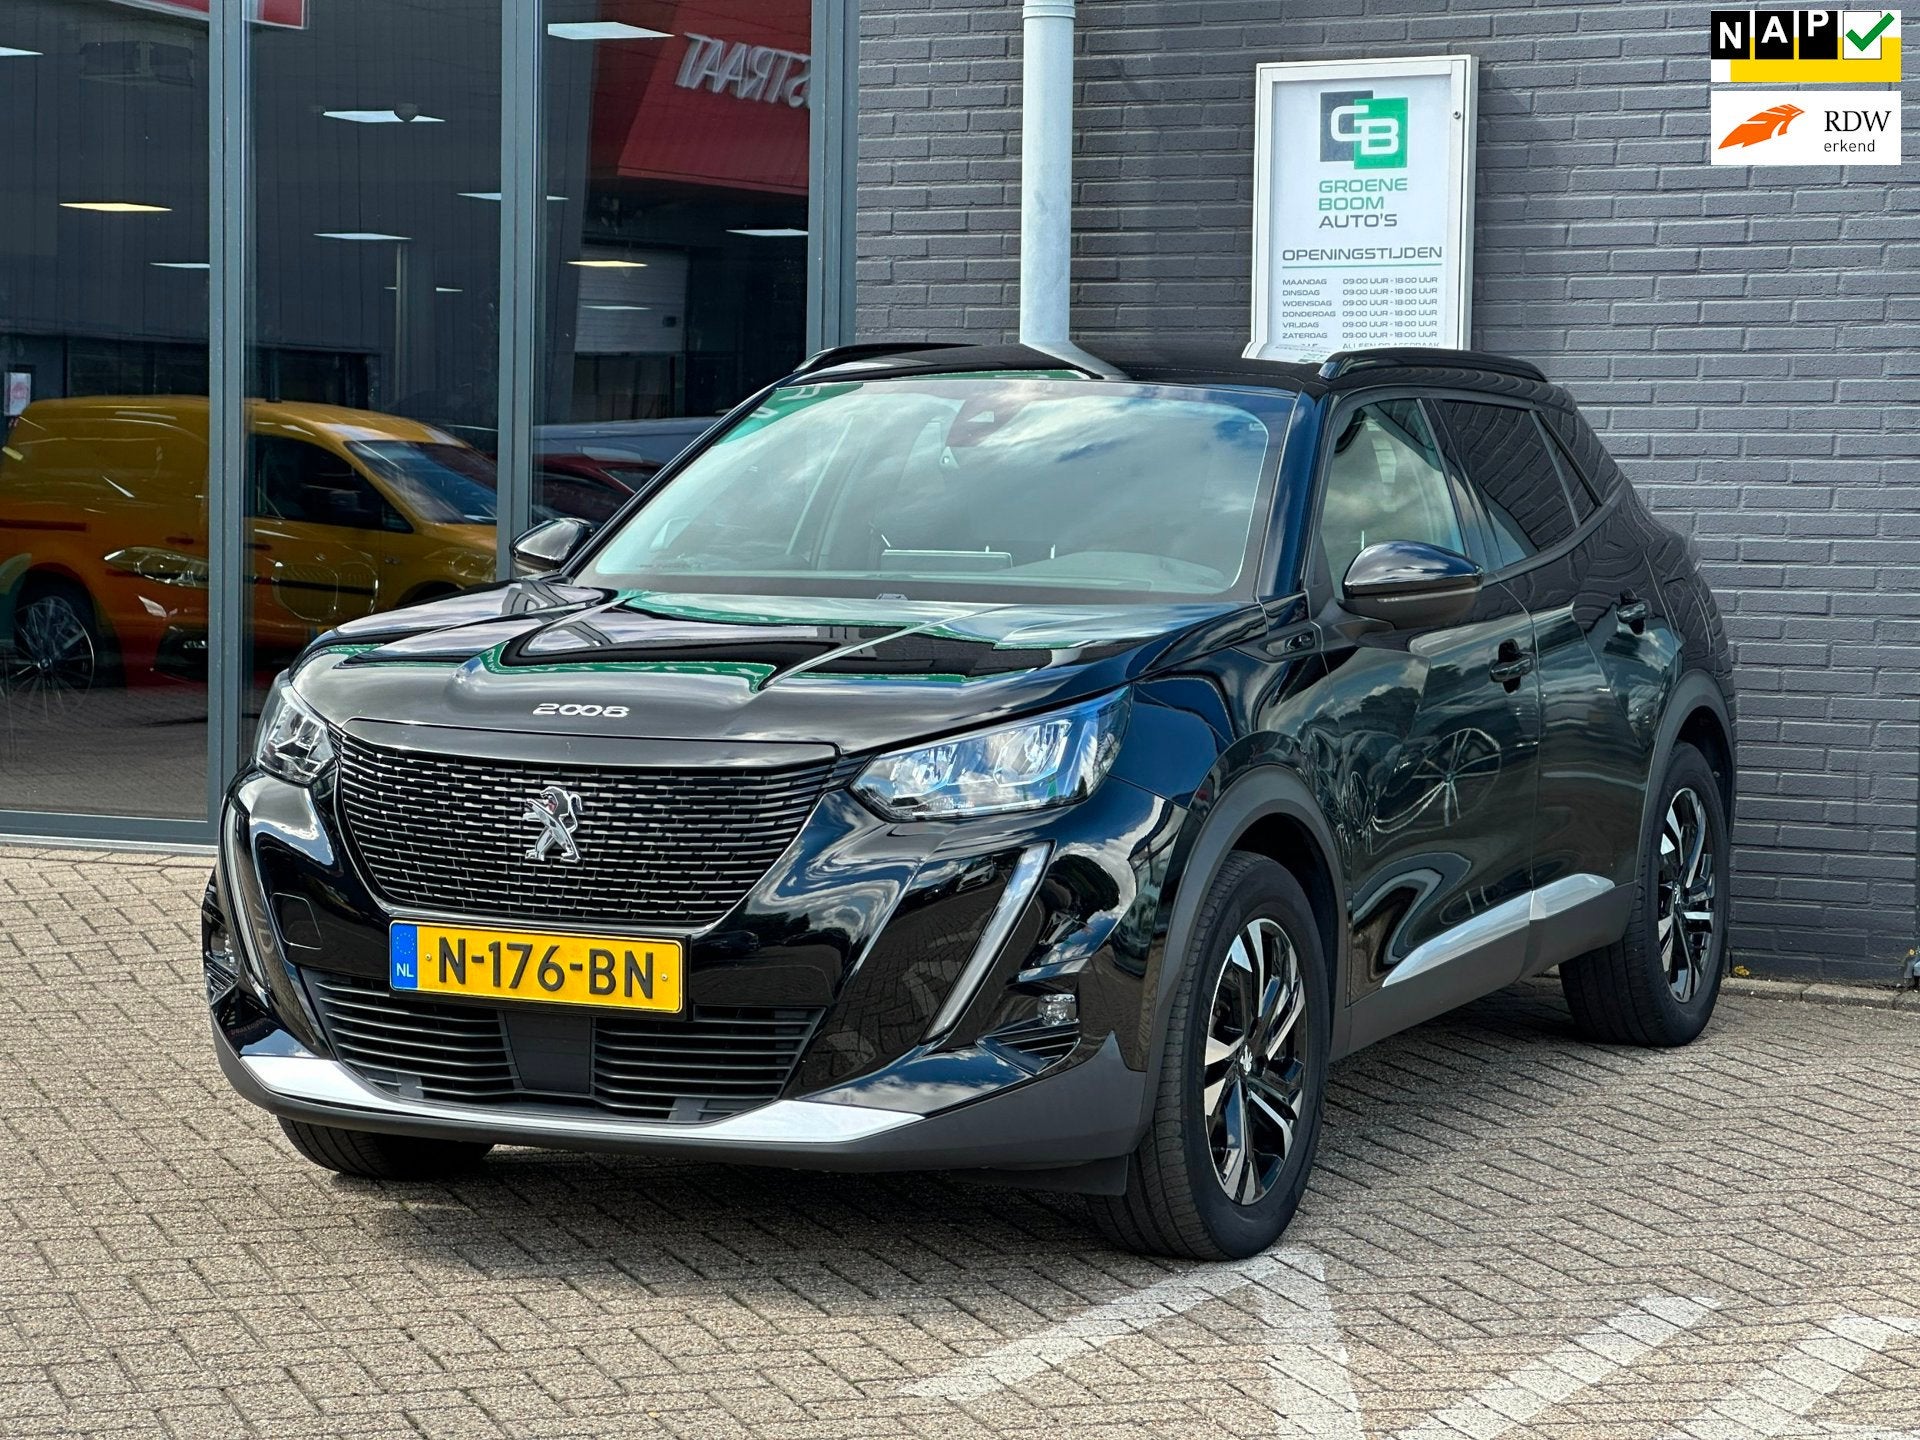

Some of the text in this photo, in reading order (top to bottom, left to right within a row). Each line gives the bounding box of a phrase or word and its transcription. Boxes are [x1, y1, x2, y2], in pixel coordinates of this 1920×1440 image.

[1319, 178, 1408, 194] GROENE
[1319, 196, 1385, 211] BOOM
[1319, 213, 1398, 229] AUTO'S
[1282, 246, 1442, 261] OPENINGSTIJDEN
[1282, 278, 1327, 286] MAANDAG
[532, 703, 630, 718] 2008
[396, 935, 654, 999] NL N-176-BN
